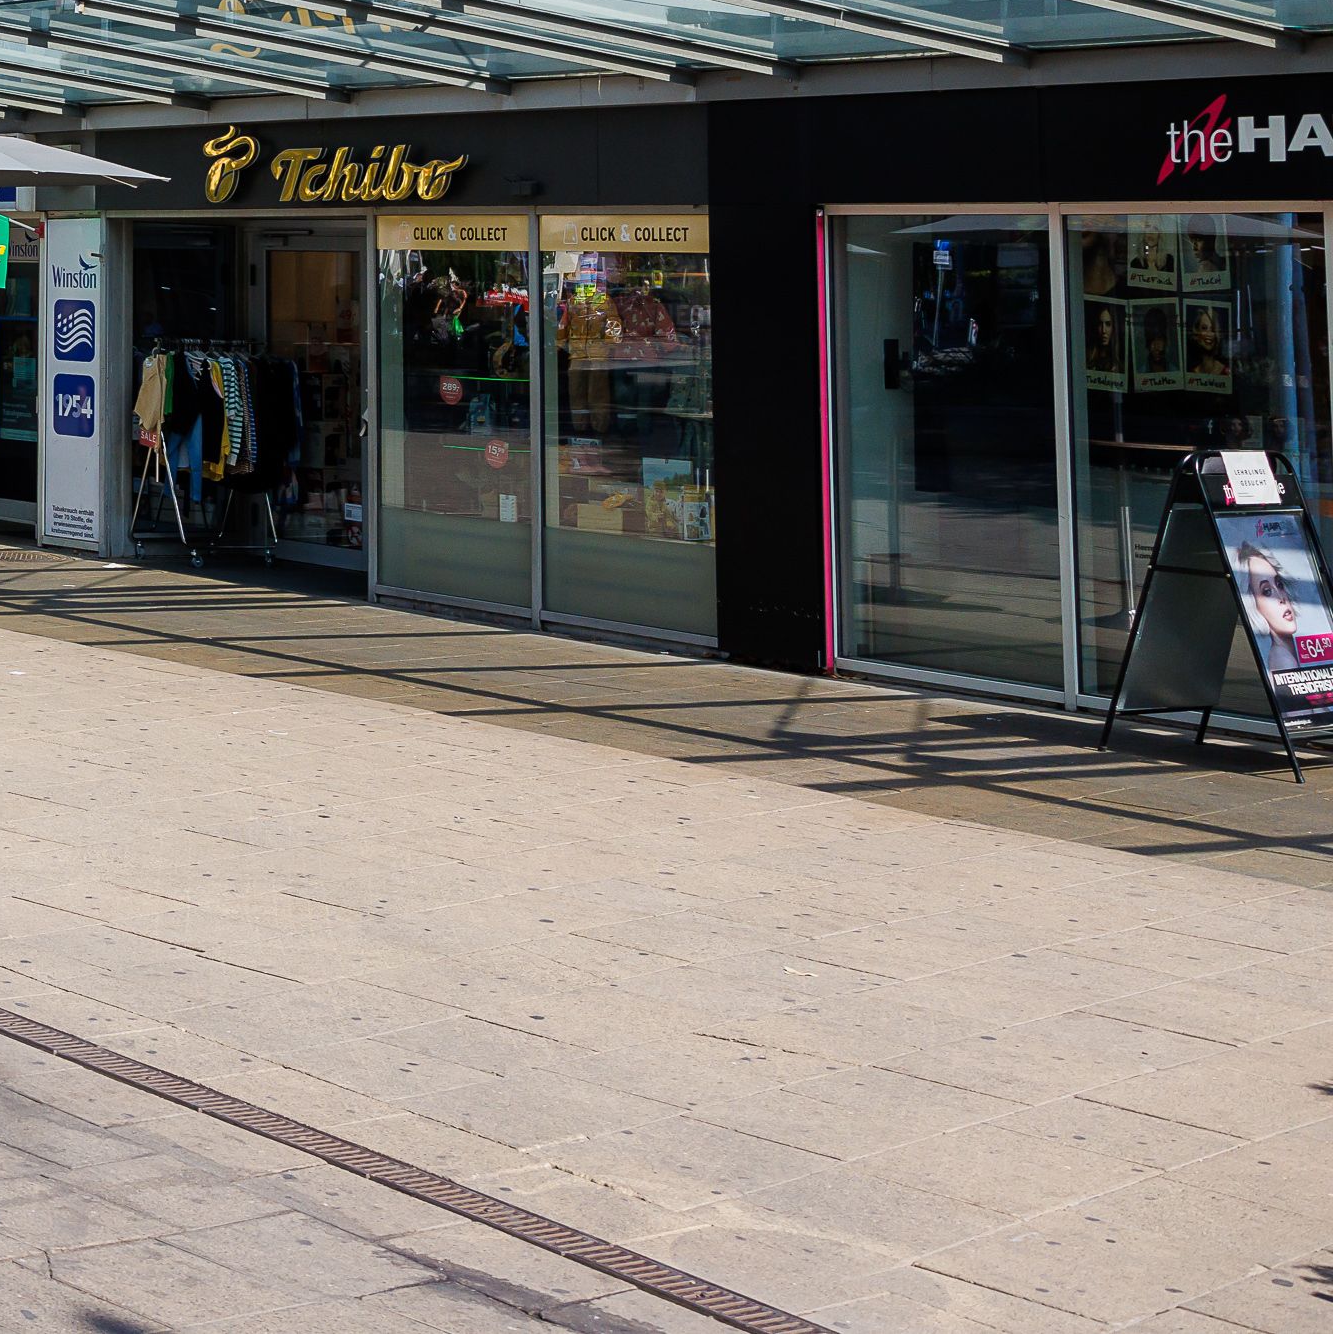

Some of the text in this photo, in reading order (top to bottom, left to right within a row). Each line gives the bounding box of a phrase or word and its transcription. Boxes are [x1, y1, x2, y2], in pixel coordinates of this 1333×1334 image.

[271, 144, 469, 202] Tchibo
[413, 224, 508, 242] CLICK & COLLECT
[580, 224, 690, 243] CLICK & COLLECT
[10, 241, 38, 258] inston
[52, 264, 97, 289] Winston
[56, 393, 93, 419] 1954
[140, 429, 157, 443] SALE
[1233, 468, 1267, 476] LEHRLINGE
[1300, 640, 1307, 651] €
